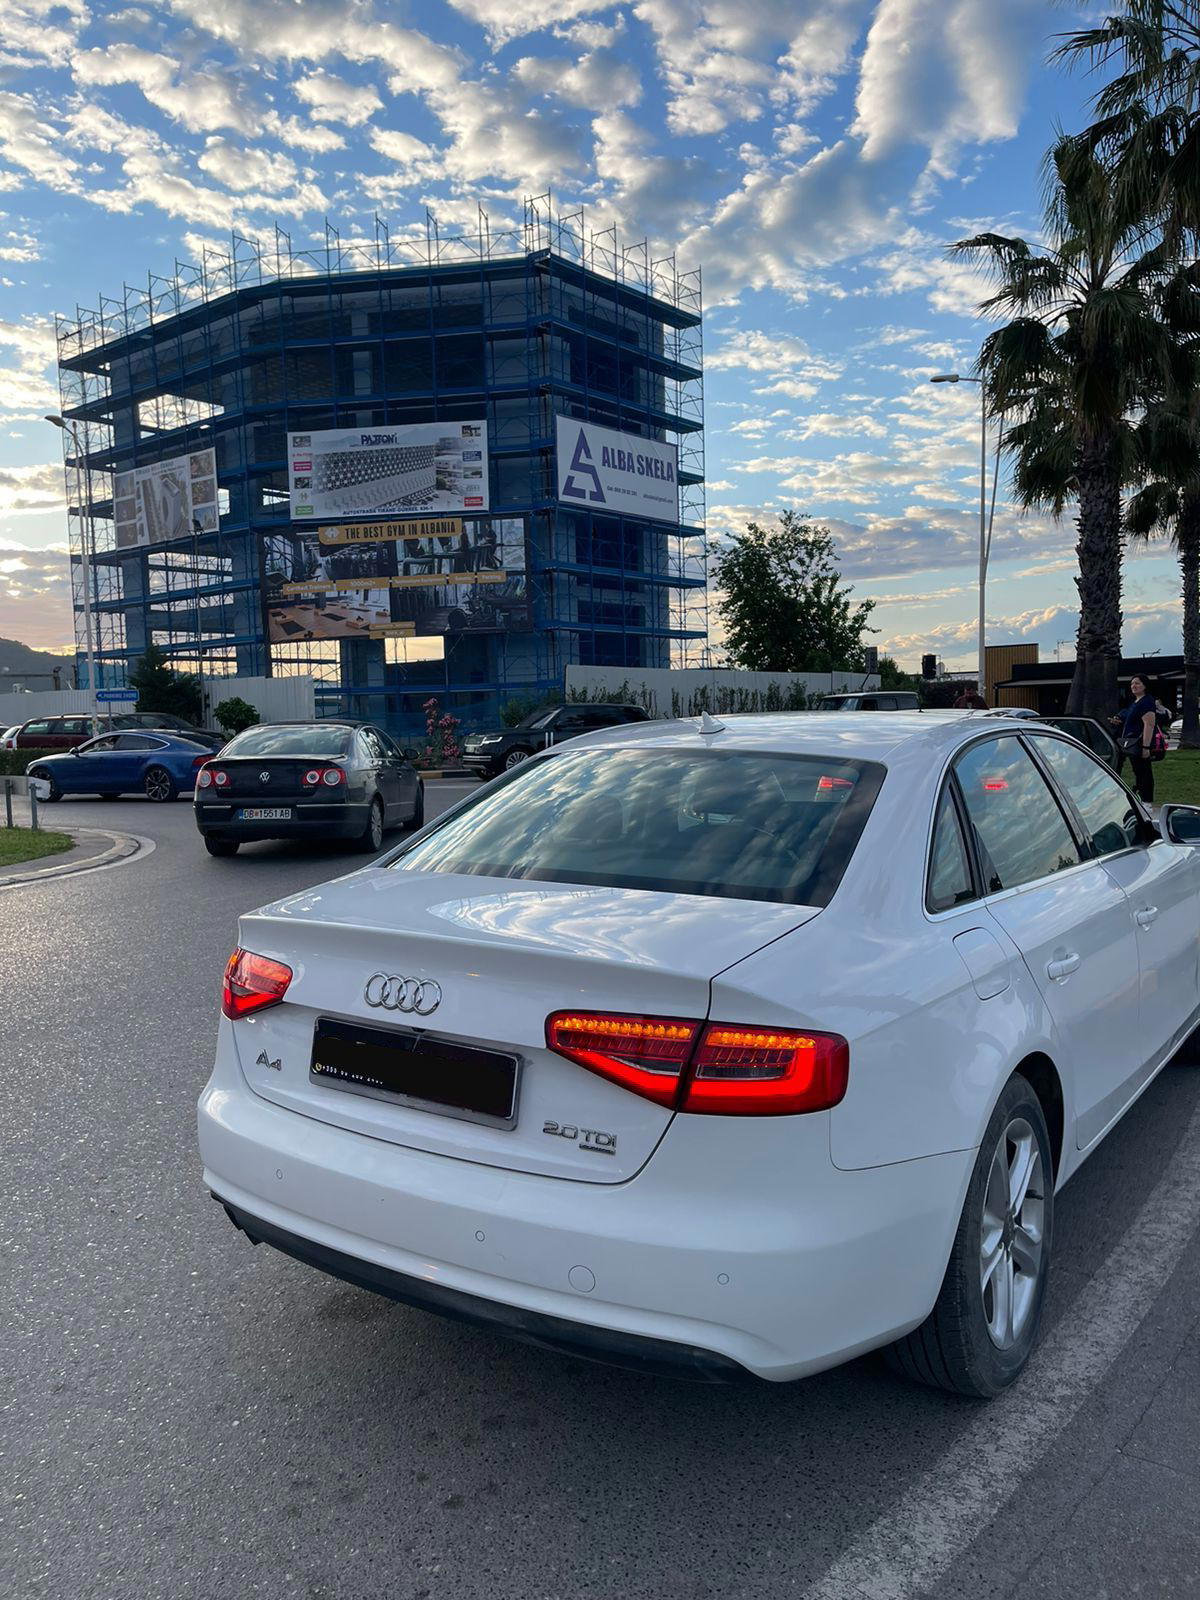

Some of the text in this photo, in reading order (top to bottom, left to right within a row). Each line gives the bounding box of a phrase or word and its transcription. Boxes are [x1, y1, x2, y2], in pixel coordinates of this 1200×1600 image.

[345, 521, 456, 539] THE BEST GYM IN ALBANIA
[260, 808, 278, 818] 1551
[280, 808, 290, 818] AB
[256, 1049, 282, 1071] A4
